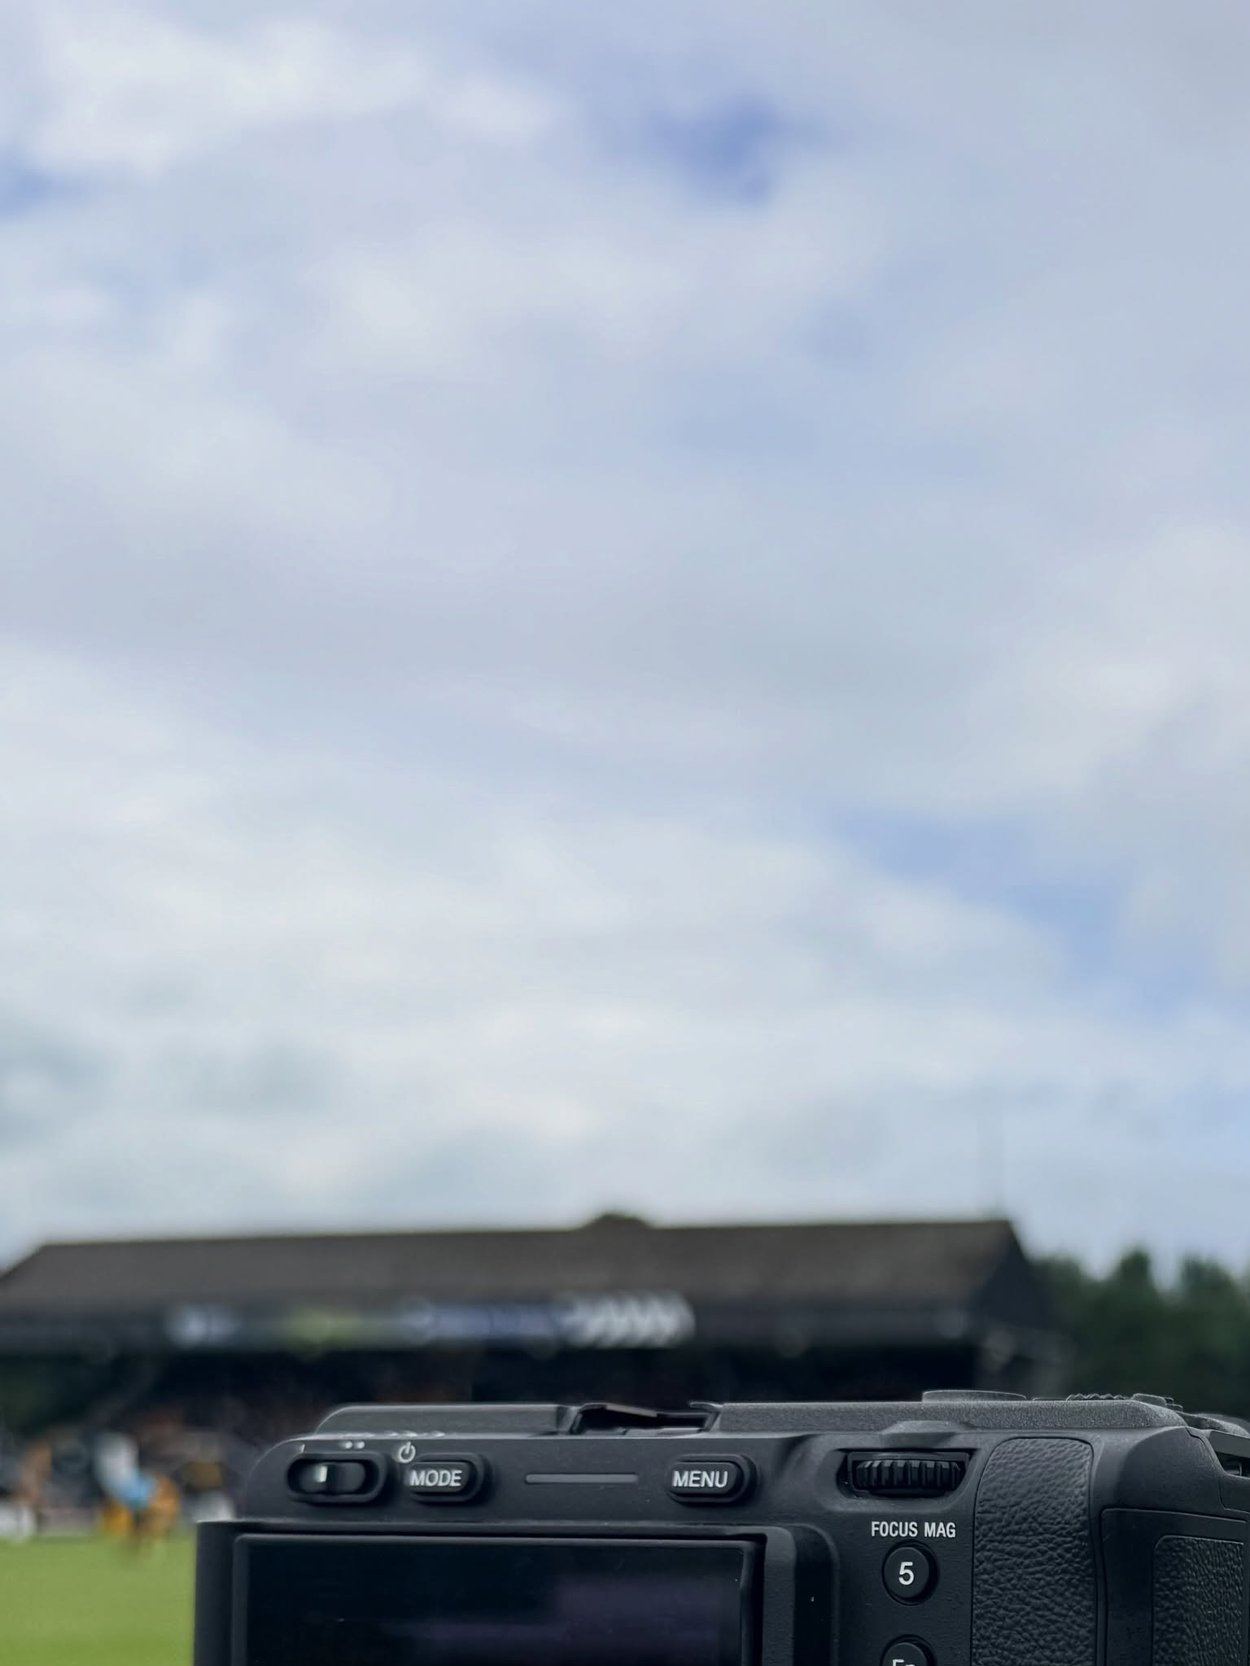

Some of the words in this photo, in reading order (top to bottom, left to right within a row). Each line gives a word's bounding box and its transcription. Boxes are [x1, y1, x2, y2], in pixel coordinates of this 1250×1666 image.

[409, 1468, 463, 1488] MODE
[672, 1469, 730, 1489] MENU
[870, 1520, 919, 1538] FOCUS
[923, 1521, 957, 1538] MAG
[898, 1561, 915, 1586] 5
